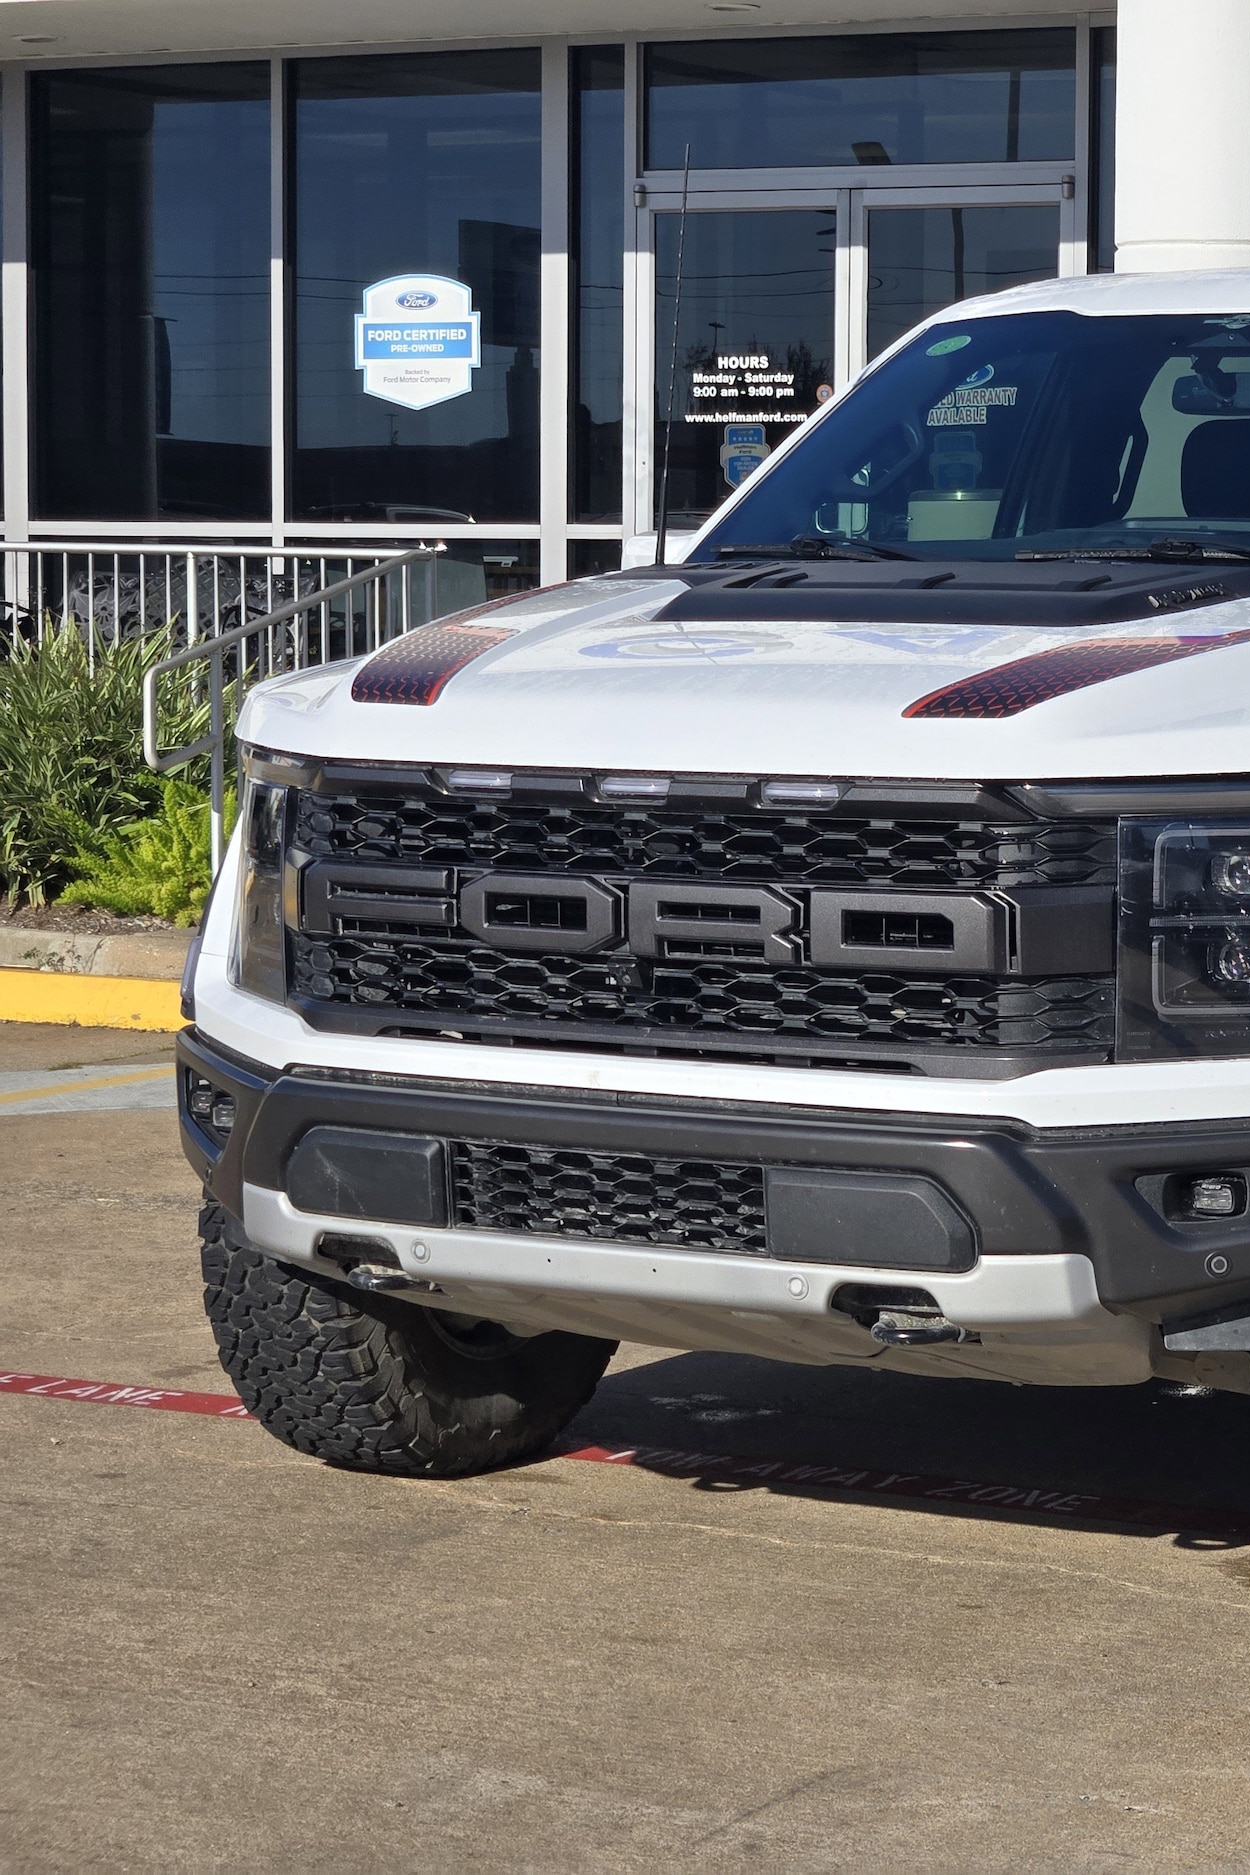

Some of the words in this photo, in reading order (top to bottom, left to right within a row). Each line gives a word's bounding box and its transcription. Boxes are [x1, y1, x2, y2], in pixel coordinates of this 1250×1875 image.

[403, 293, 431, 308] Ford
[368, 330, 401, 342] FORD
[403, 329, 467, 341] CERTIFIED
[390, 343, 444, 353] PRE-OWNED
[717, 356, 769, 369] HOURS
[420, 376, 451, 385] Company
[693, 373, 736, 385] Monday
[744, 372, 795, 385] Saturday
[693, 387, 717, 397] 9:00
[720, 388, 739, 397] am
[748, 386, 774, 397] 9:00
[776, 388, 795, 399] pm
[956, 388, 1018, 406] WARRANTY
[685, 412, 808, 423] www.helfmanford.com
[927, 408, 987, 425] AVAILABLE
[303, 863, 1008, 975] FORD
[24, 1379, 184, 1405] LANE
[734, 1461, 919, 1490] AWAY
[926, 1480, 1101, 1512] ZONE
